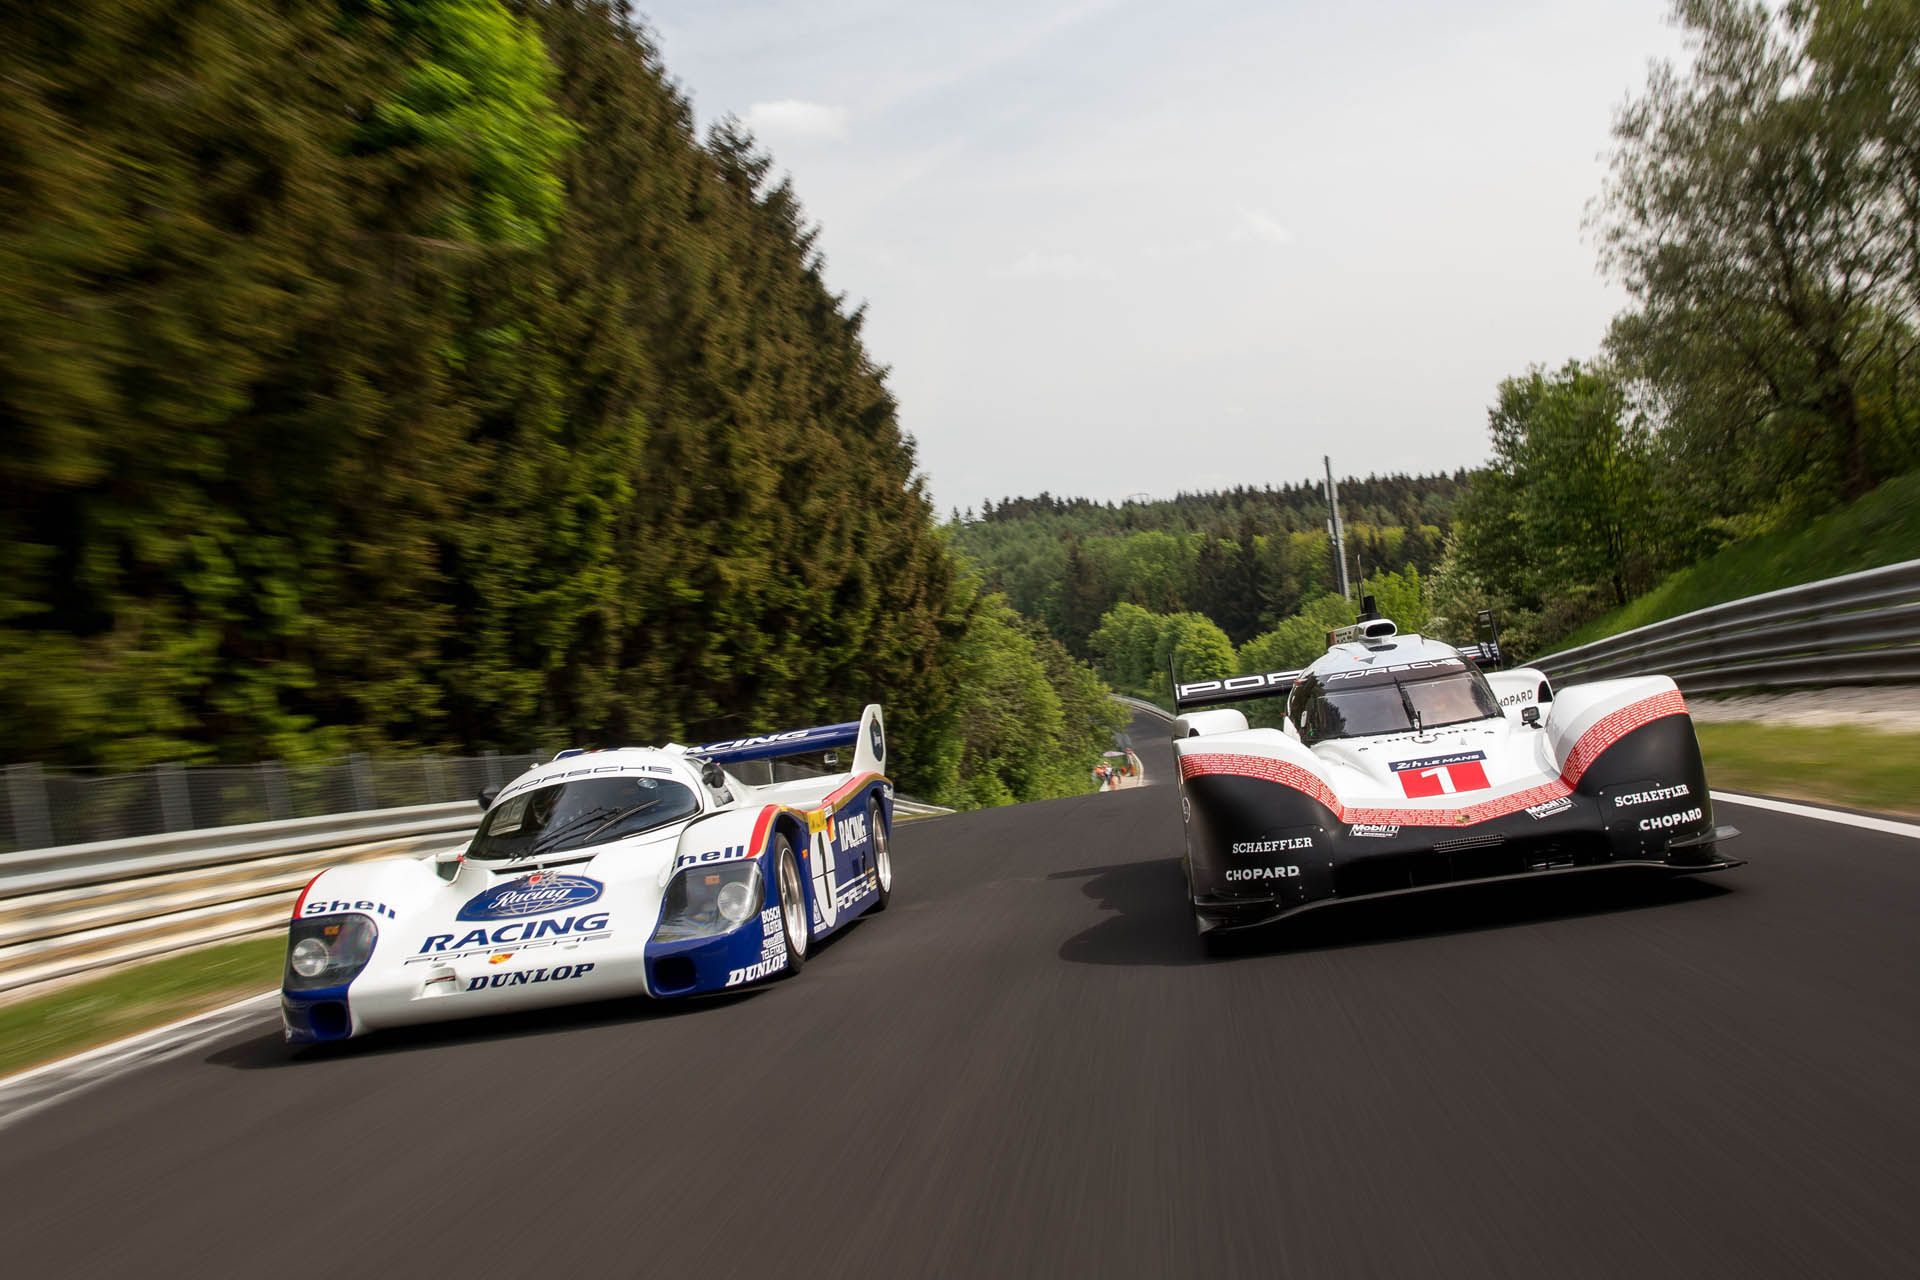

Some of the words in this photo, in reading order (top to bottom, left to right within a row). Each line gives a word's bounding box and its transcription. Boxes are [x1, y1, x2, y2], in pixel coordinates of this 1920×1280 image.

[1327, 658, 1465, 684] PORSCHE
[1499, 690, 1533, 707] OPARD
[687, 729, 809, 754] ACING
[1442, 754, 1480, 764] MANS
[500, 765, 673, 799] PORSCHE
[1421, 765, 1457, 794] 1
[1614, 784, 1689, 807] SCHAEFFLER
[1351, 824, 1388, 832] Mobil
[1639, 807, 1702, 831] CHOPARD
[677, 845, 744, 868] hell
[1232, 837, 1313, 855] SCHAEFFLER
[1226, 865, 1300, 881] CHOPARD
[488, 887, 572, 909] Racing
[305, 900, 396, 920] Shell
[761, 905, 781, 924] BOSCH
[419, 913, 610, 954] RACING
[466, 962, 595, 992] DUNLOP
[725, 952, 787, 987] DUNLOP
